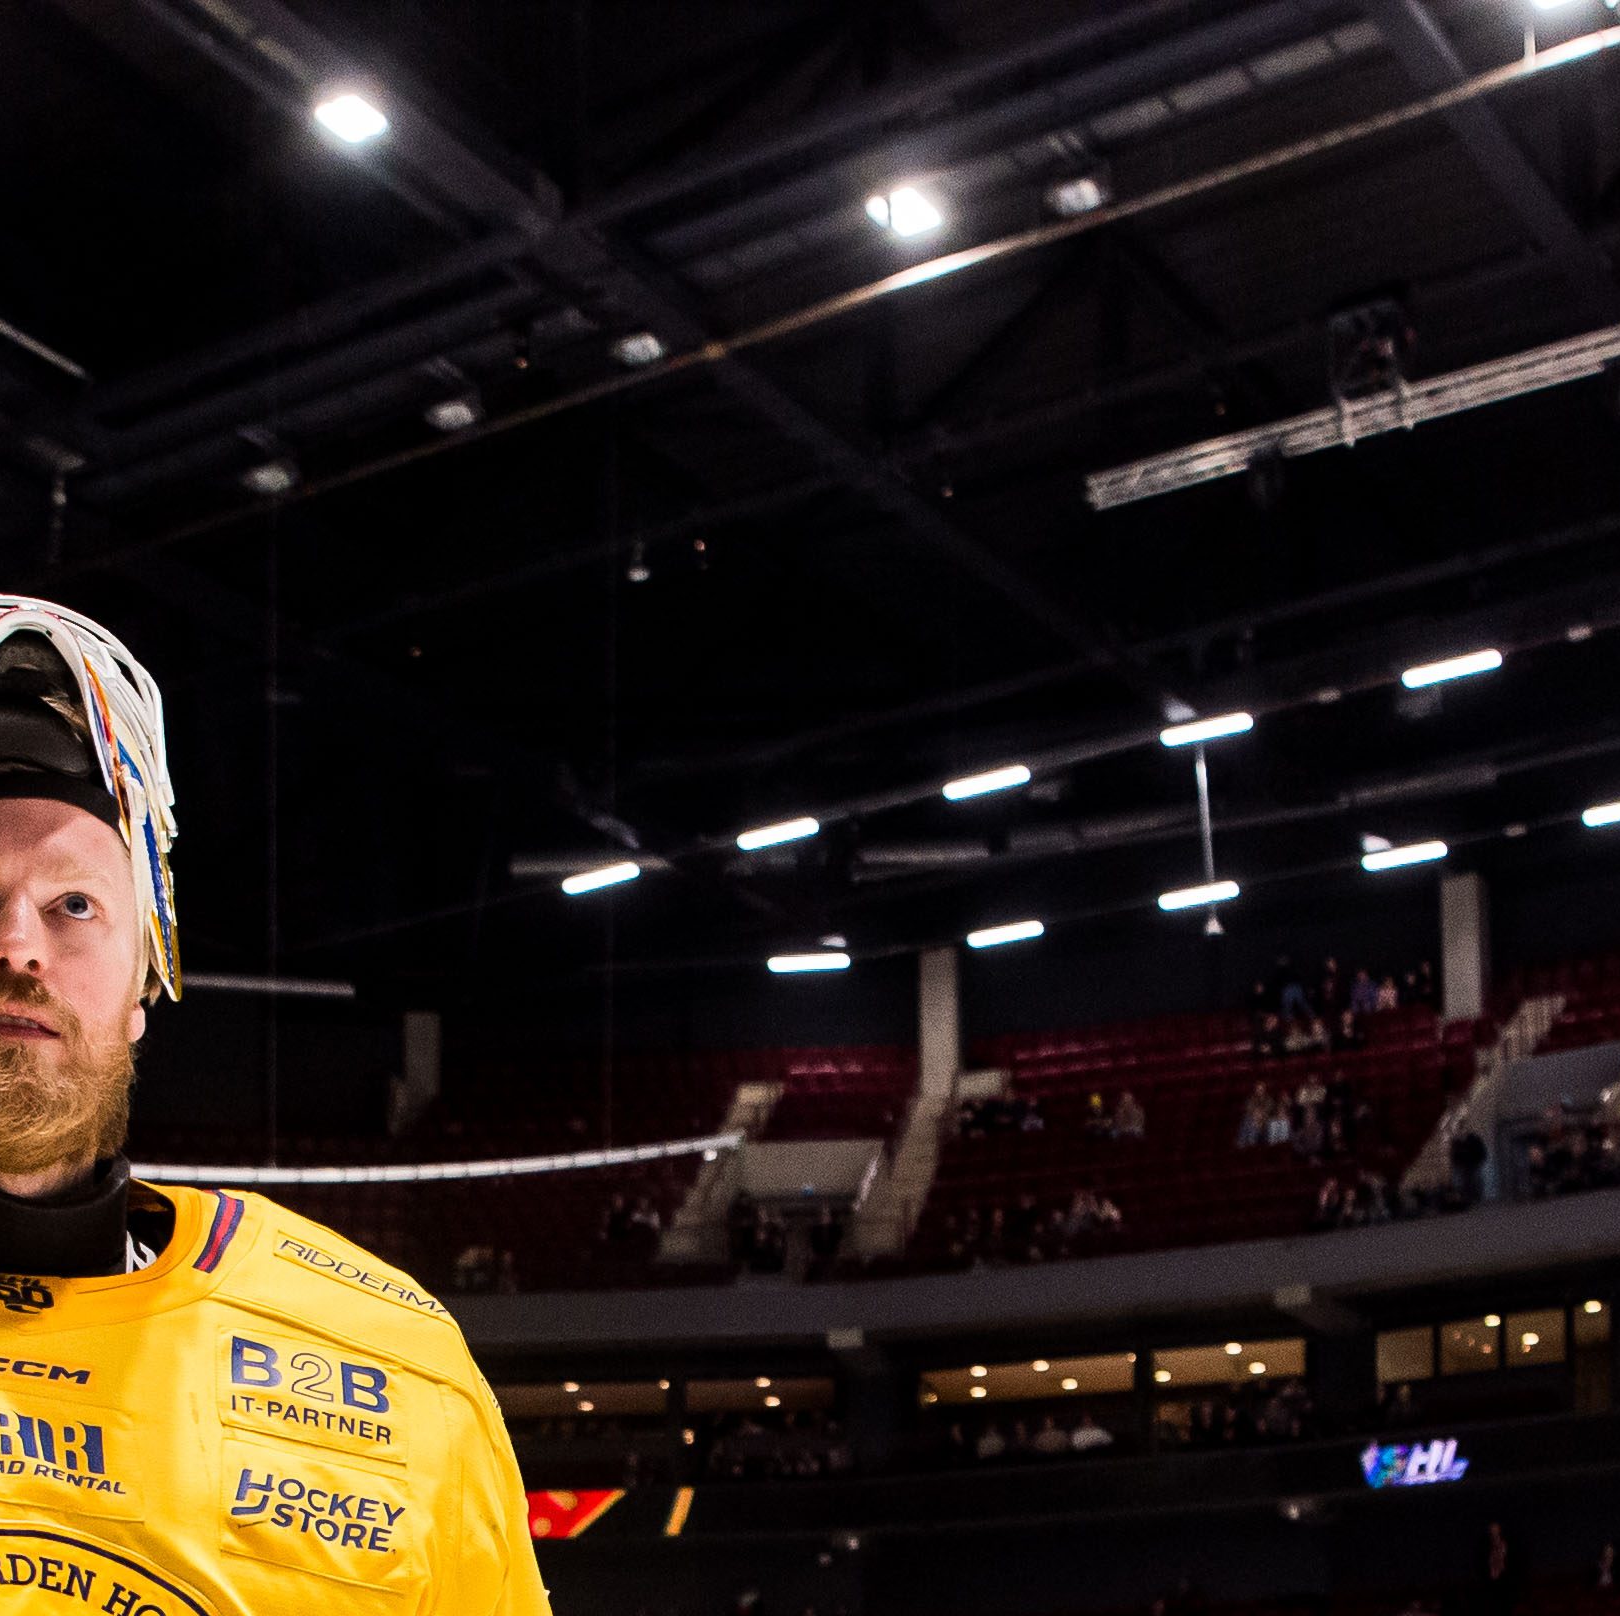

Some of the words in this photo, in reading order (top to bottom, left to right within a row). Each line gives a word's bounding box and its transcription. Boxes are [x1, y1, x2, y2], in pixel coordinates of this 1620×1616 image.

[280, 1238, 448, 1314] RIDDERM
[230, 1334, 391, 1414] B2B
[231, 1395, 394, 1445] IT-PARTNER
[33, 1462, 127, 1495] RENTAL
[232, 1468, 407, 1528] HOCKEY
